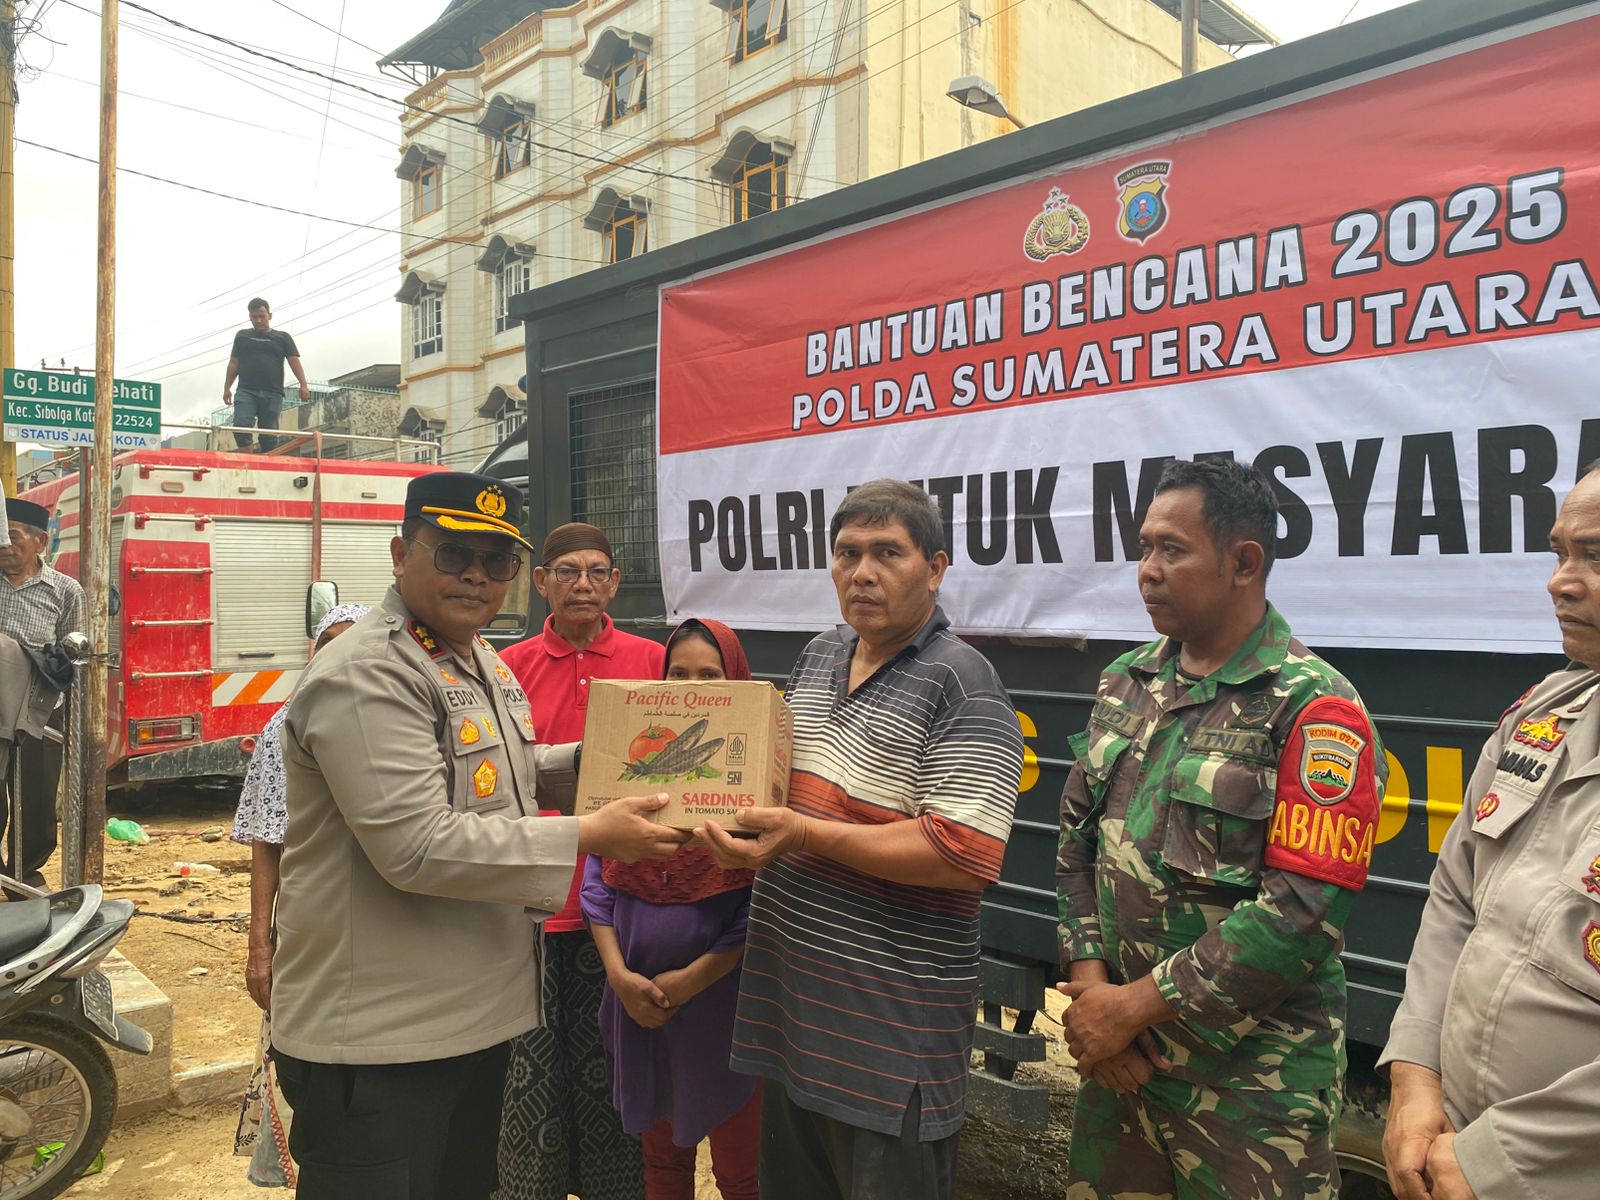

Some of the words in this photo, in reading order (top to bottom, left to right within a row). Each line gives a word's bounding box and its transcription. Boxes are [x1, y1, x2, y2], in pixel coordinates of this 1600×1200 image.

[806, 289, 1003, 377] BANTUAN
[1021, 224, 1306, 335] BENCANA
[1332, 167, 1566, 278] 2025
[792, 372, 935, 430] POLDA
[951, 313, 1279, 407] SUMATERA
[1304, 257, 1600, 357] UTARA
[13, 372, 42, 394] Gg.
[48, 375, 87, 395] Budi
[112, 382, 153, 400] ehati
[8, 402, 31, 418] Kec.
[35, 404, 72, 424] Sibolga
[115, 414, 153, 428] 22524
[21, 428, 69, 441] STATUS
[72, 432, 95, 443] JAL
[115, 435, 147, 446] KOTA
[688, 488, 826, 572] POLRI
[847, 466, 1063, 566] TUK
[1092, 418, 1600, 562] MSYAR
[446, 690, 478, 707] EDDY
[624, 689, 679, 709] Pacific
[684, 691, 732, 710] Queen
[1203, 732, 1237, 750] TNI
[1308, 728, 1337, 738] KODIM
[681, 792, 755, 807] SARDINES
[684, 807, 693, 815] IN
[695, 807, 725, 815] TOMATO
[1267, 800, 1374, 867] ABINSA
